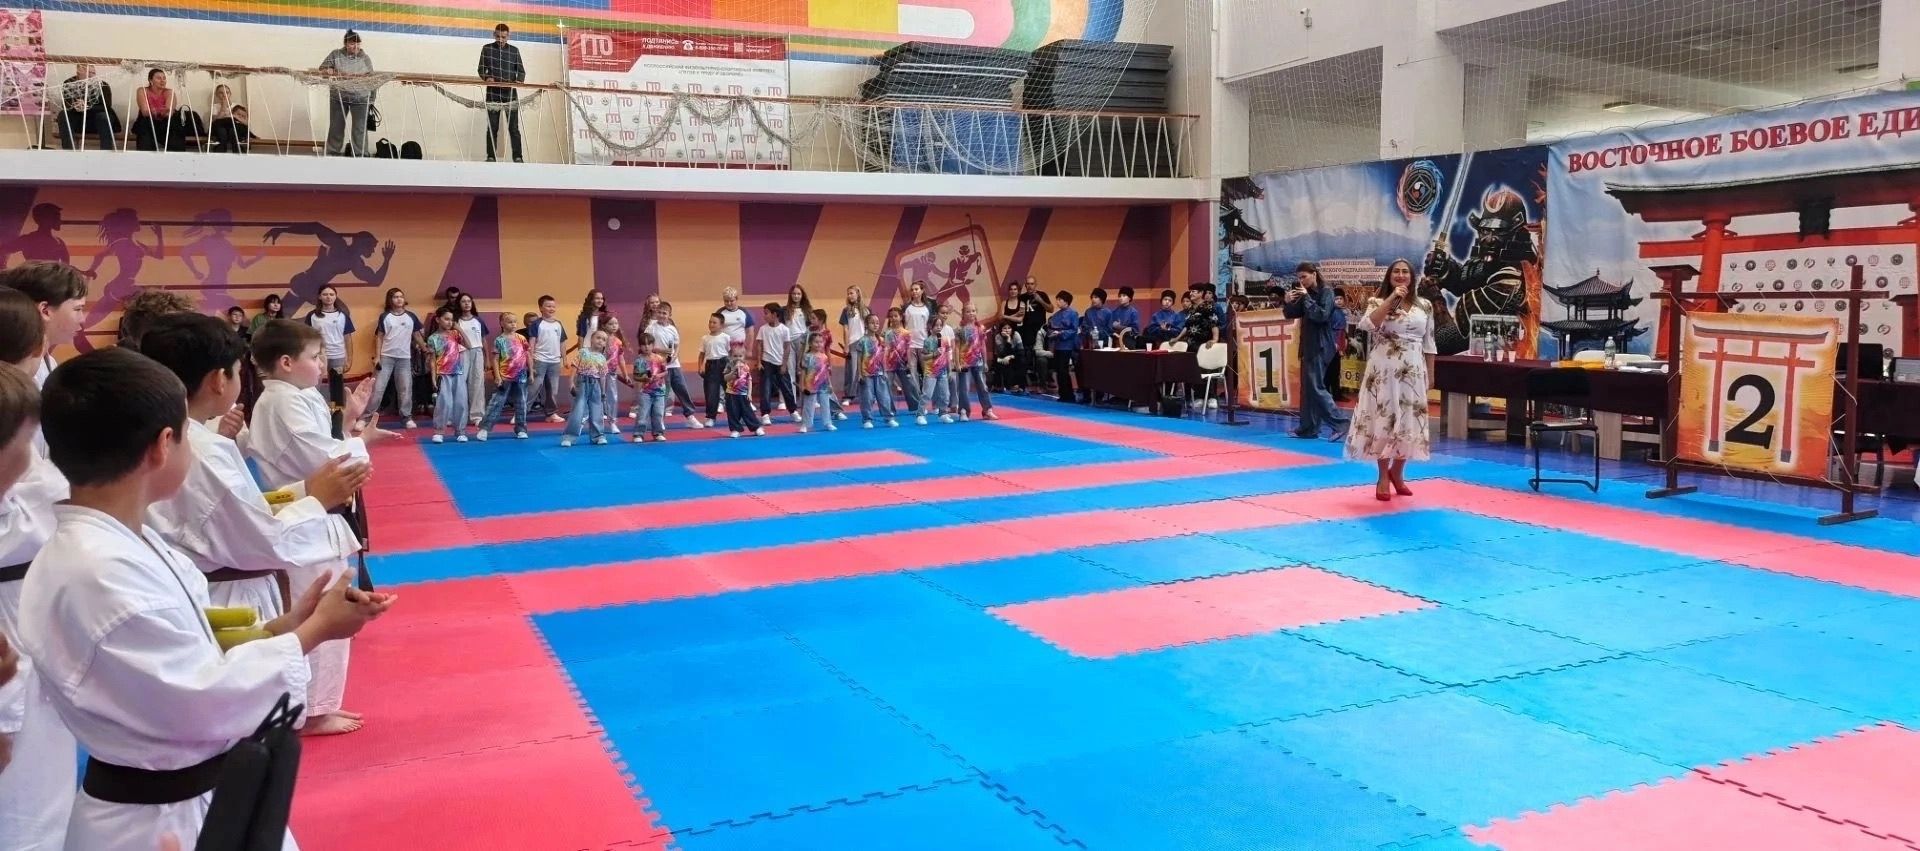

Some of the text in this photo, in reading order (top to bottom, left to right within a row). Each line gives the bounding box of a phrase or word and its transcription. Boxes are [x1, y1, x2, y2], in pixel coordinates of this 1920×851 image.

[580, 33, 614, 56] ГТО
[642, 37, 679, 45] ПОДТЯНИСЬ
[604, 80, 618, 89] ГТО
[647, 82, 660, 92] ГТО
[688, 83, 702, 92] ГТО
[728, 85, 742, 94] ГТО
[768, 87, 782, 96] ГТО
[606, 114, 620, 123] ГТО
[620, 130, 634, 140] ГТО
[703, 133, 717, 143] ГТО
[1568, 134, 1722, 173] ВОСТОЧНОЕ
[1730, 115, 1850, 153] БОЕВОЕ
[691, 149, 705, 158] ГТО
[731, 150, 745, 160] ГТО
[1259, 347, 1279, 394] 1
[1725, 374, 1775, 450] 2
